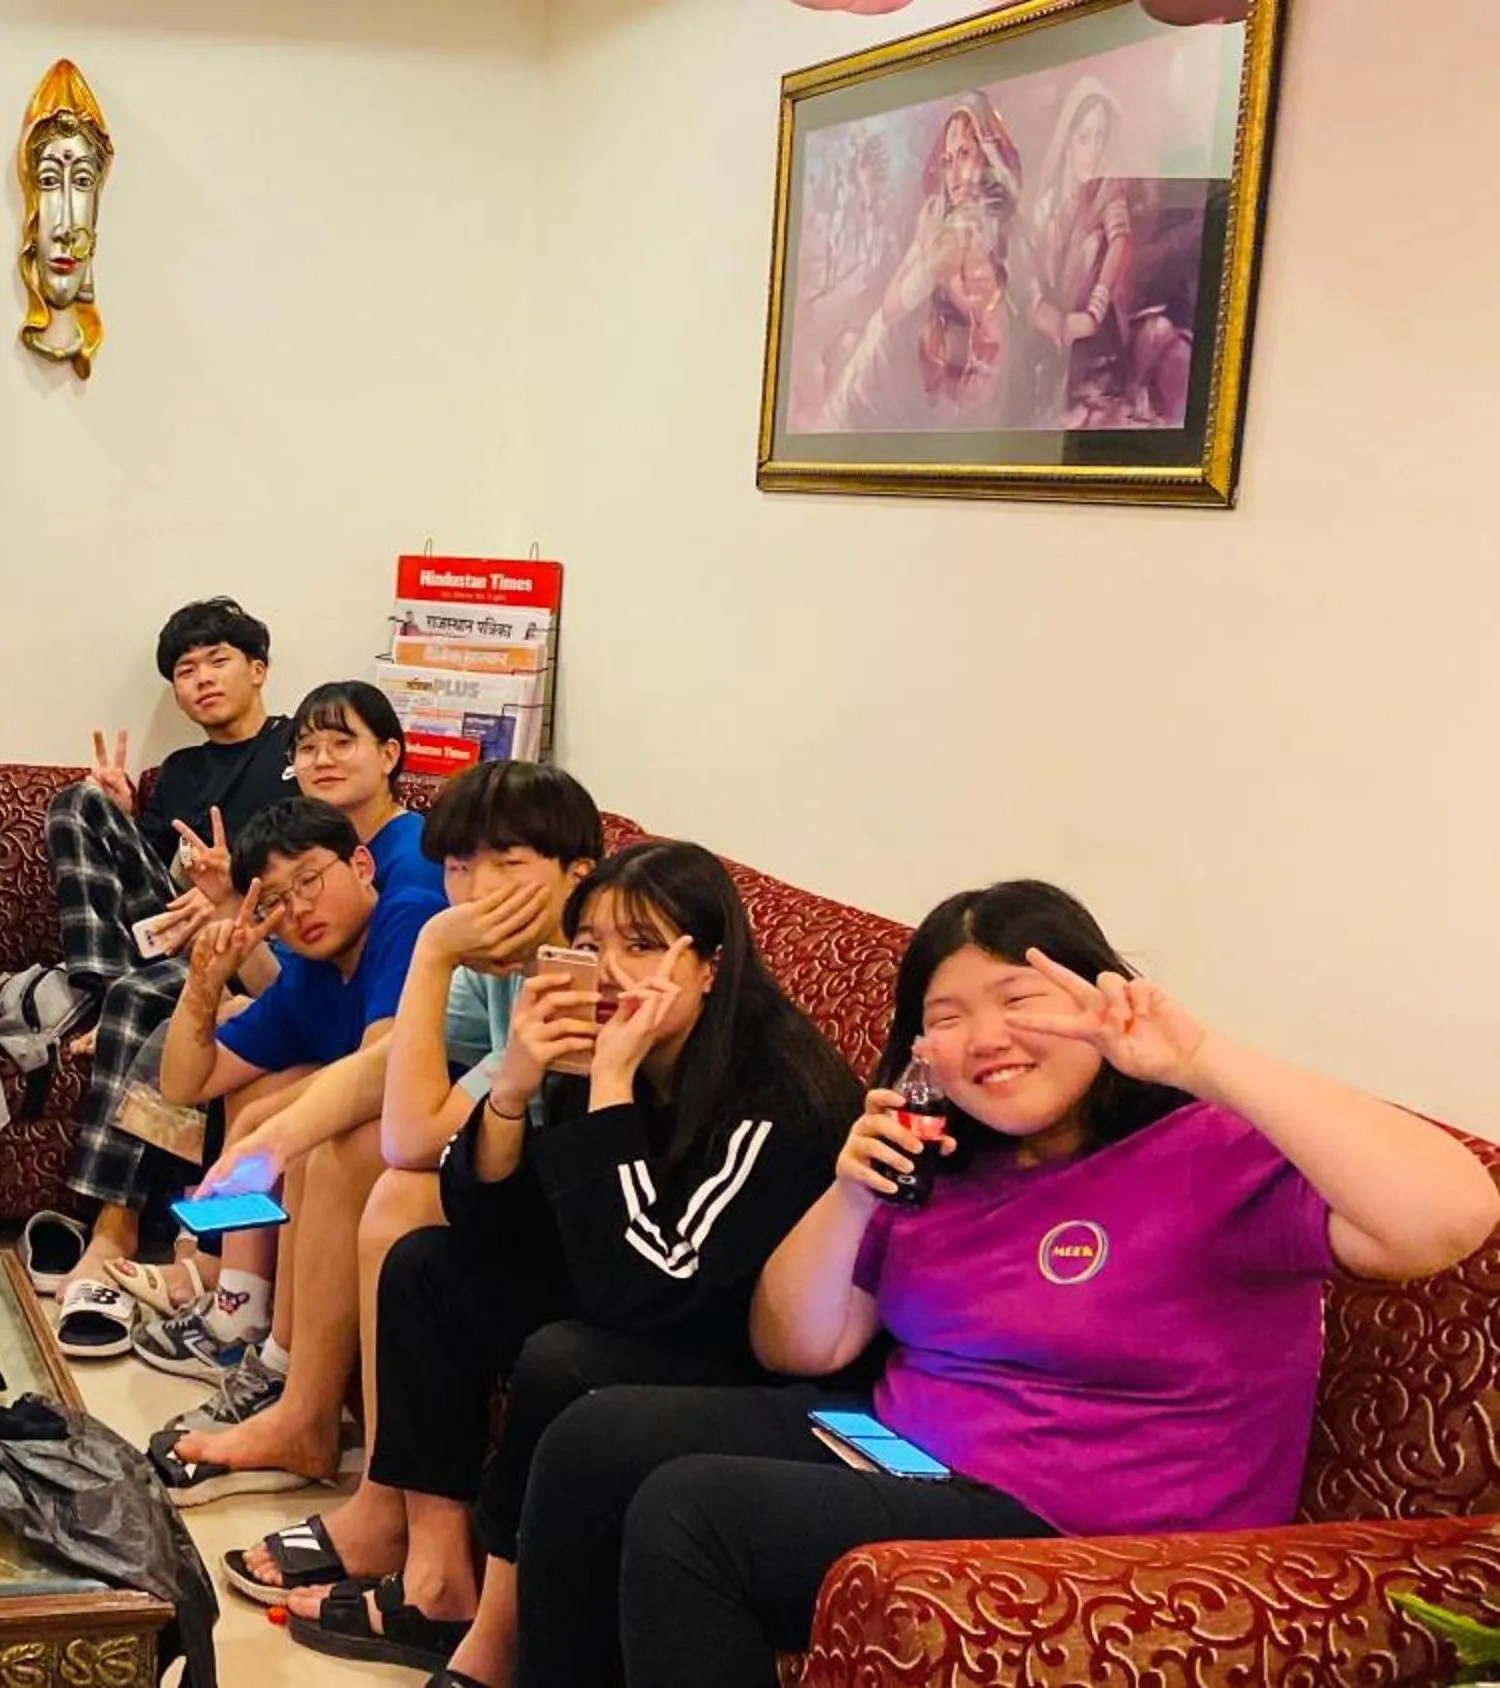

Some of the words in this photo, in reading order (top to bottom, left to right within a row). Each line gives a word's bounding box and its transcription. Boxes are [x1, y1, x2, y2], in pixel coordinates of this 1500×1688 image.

[420, 569, 487, 589] Hindustan
[490, 573, 533, 591] Times
[433, 678, 480, 699] PLUS
